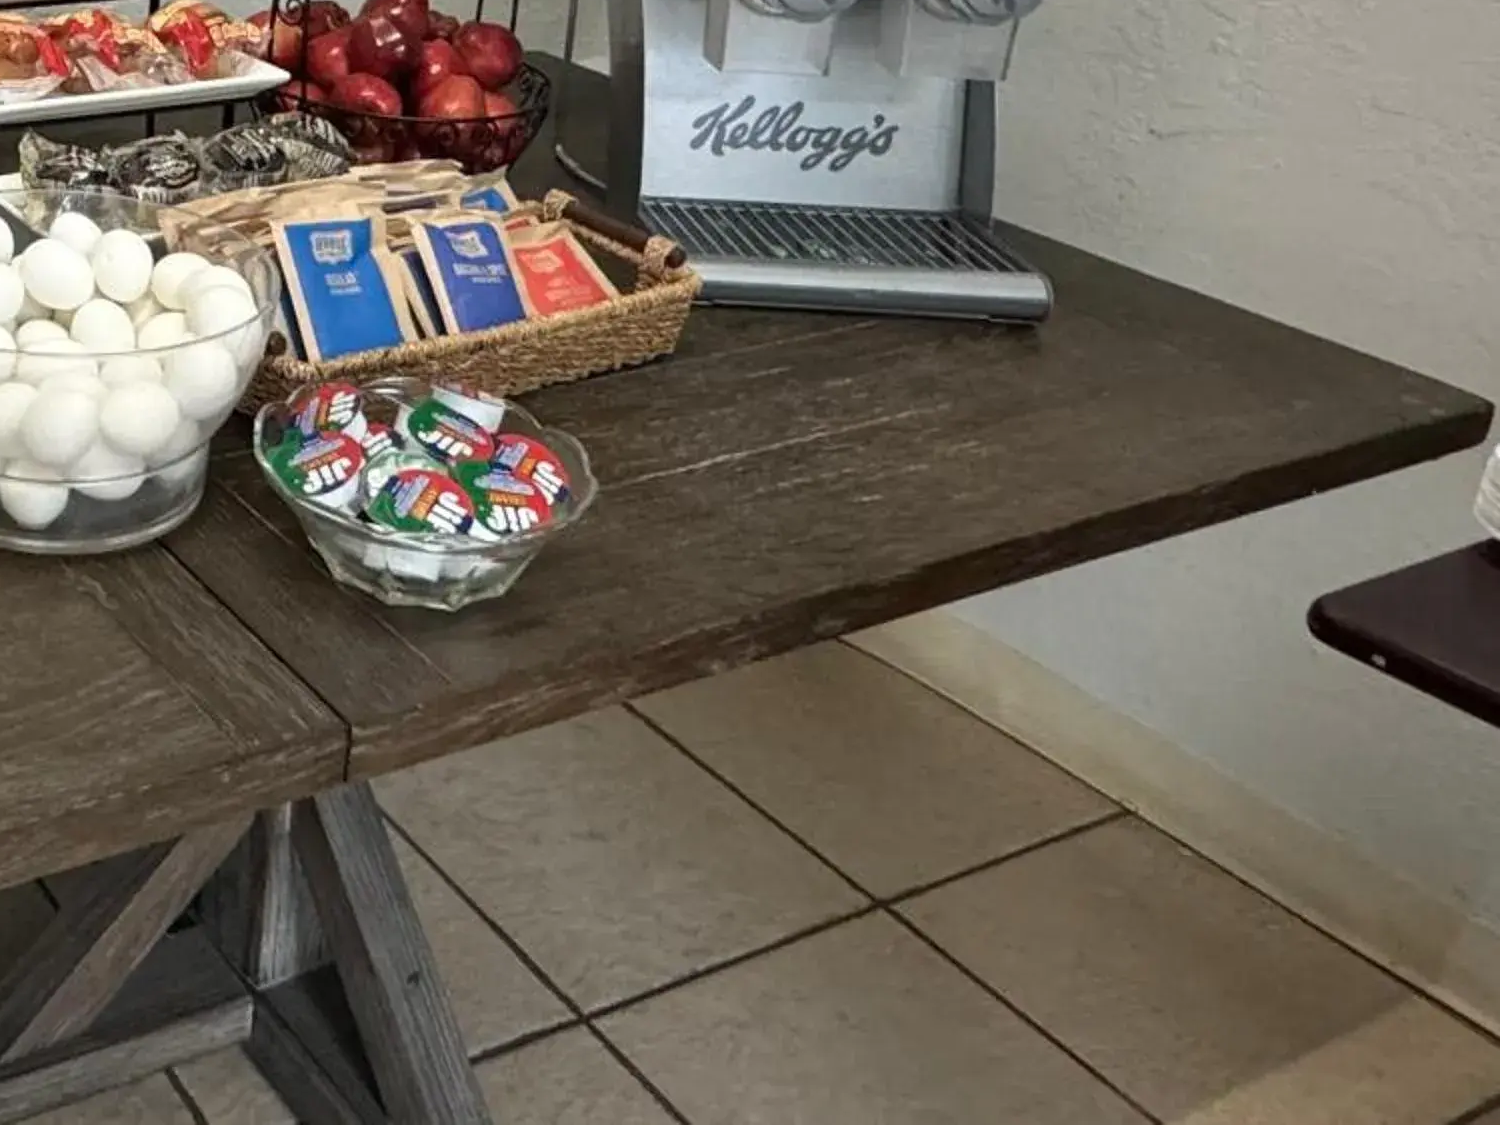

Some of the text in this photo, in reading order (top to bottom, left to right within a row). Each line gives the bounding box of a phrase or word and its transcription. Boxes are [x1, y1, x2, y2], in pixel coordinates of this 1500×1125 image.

[690, 94, 899, 172] Kellogg's
[417, 429, 474, 457] JIF
[303, 457, 353, 494] JIF
[486, 504, 539, 532] JIF
